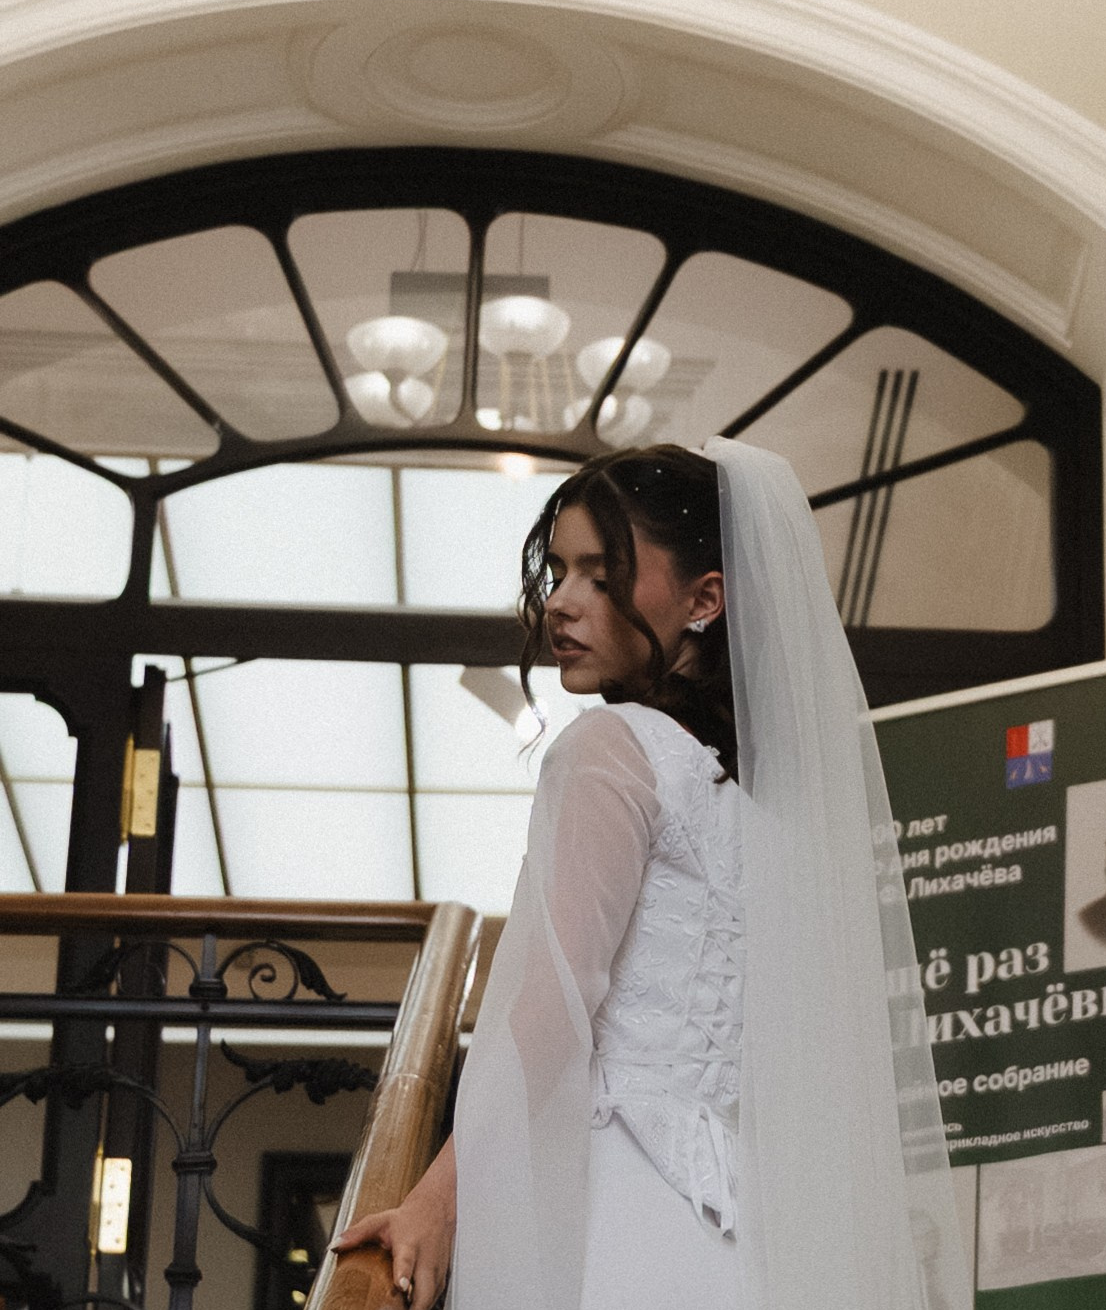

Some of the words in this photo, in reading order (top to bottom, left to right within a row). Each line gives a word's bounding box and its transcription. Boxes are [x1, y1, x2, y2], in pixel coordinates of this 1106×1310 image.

[906, 814, 948, 838] лет
[934, 825, 1057, 869] рождения
[907, 863, 1023, 900] Лихачёва
[965, 942, 1050, 994] раз
[972, 1057, 1091, 1092] собрание
[946, 1131, 1022, 1152] рикладное
[1022, 1119, 1090, 1140] искусство
